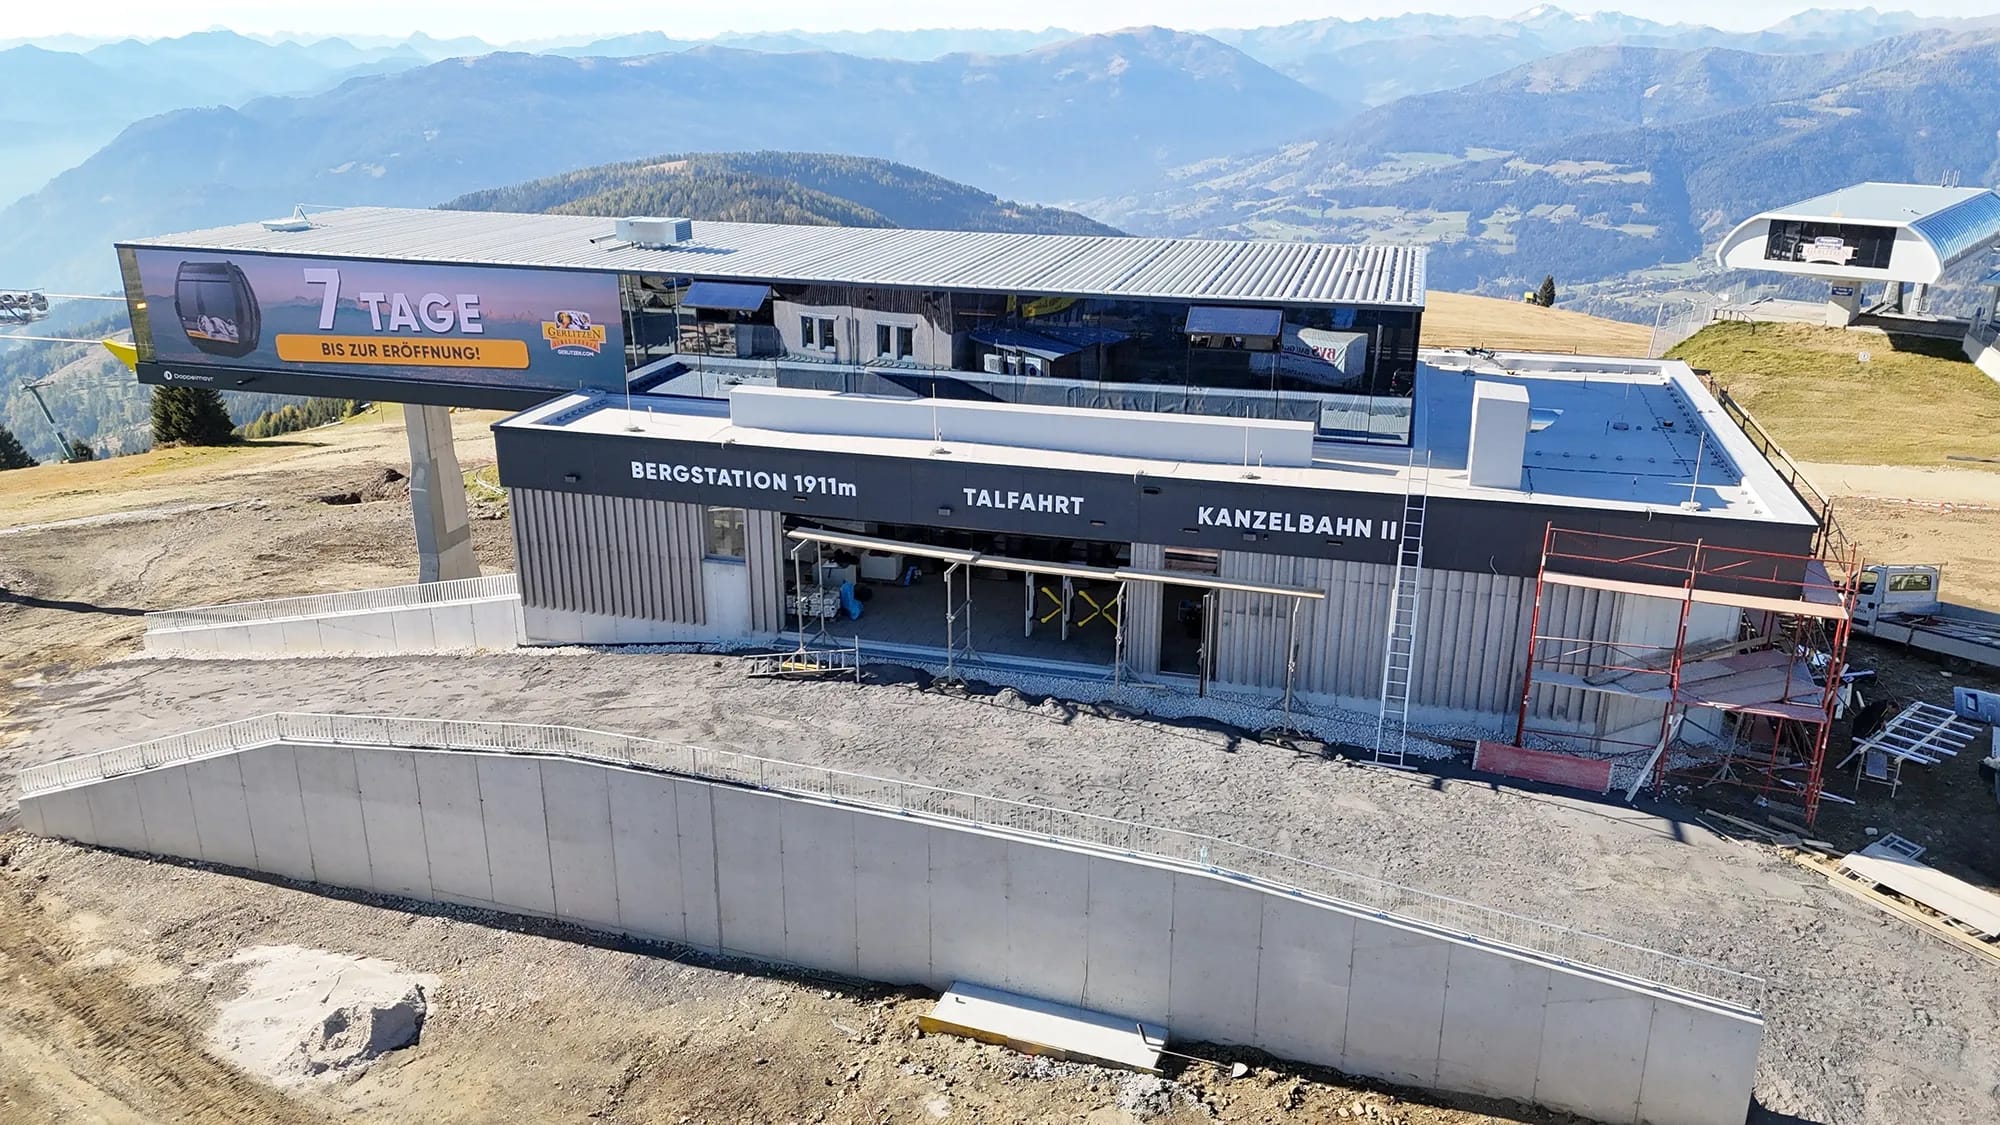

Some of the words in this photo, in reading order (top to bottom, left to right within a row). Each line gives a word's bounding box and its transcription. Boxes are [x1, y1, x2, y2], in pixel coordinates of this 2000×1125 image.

[304, 268, 341, 330] 7
[360, 292, 484, 334] TAGE
[547, 327, 601, 339] GERLITZEN
[321, 343, 345, 356] BIS
[349, 344, 378, 358] ZUR
[383, 342, 481, 361] ERÖFFNUNG!
[631, 461, 787, 491] BERGSTATION
[793, 474, 857, 497] 1911m
[963, 488, 1085, 515] TALFAHRT
[1197, 506, 1372, 538] KANZELBAHN
[1381, 520, 1397, 540] II
